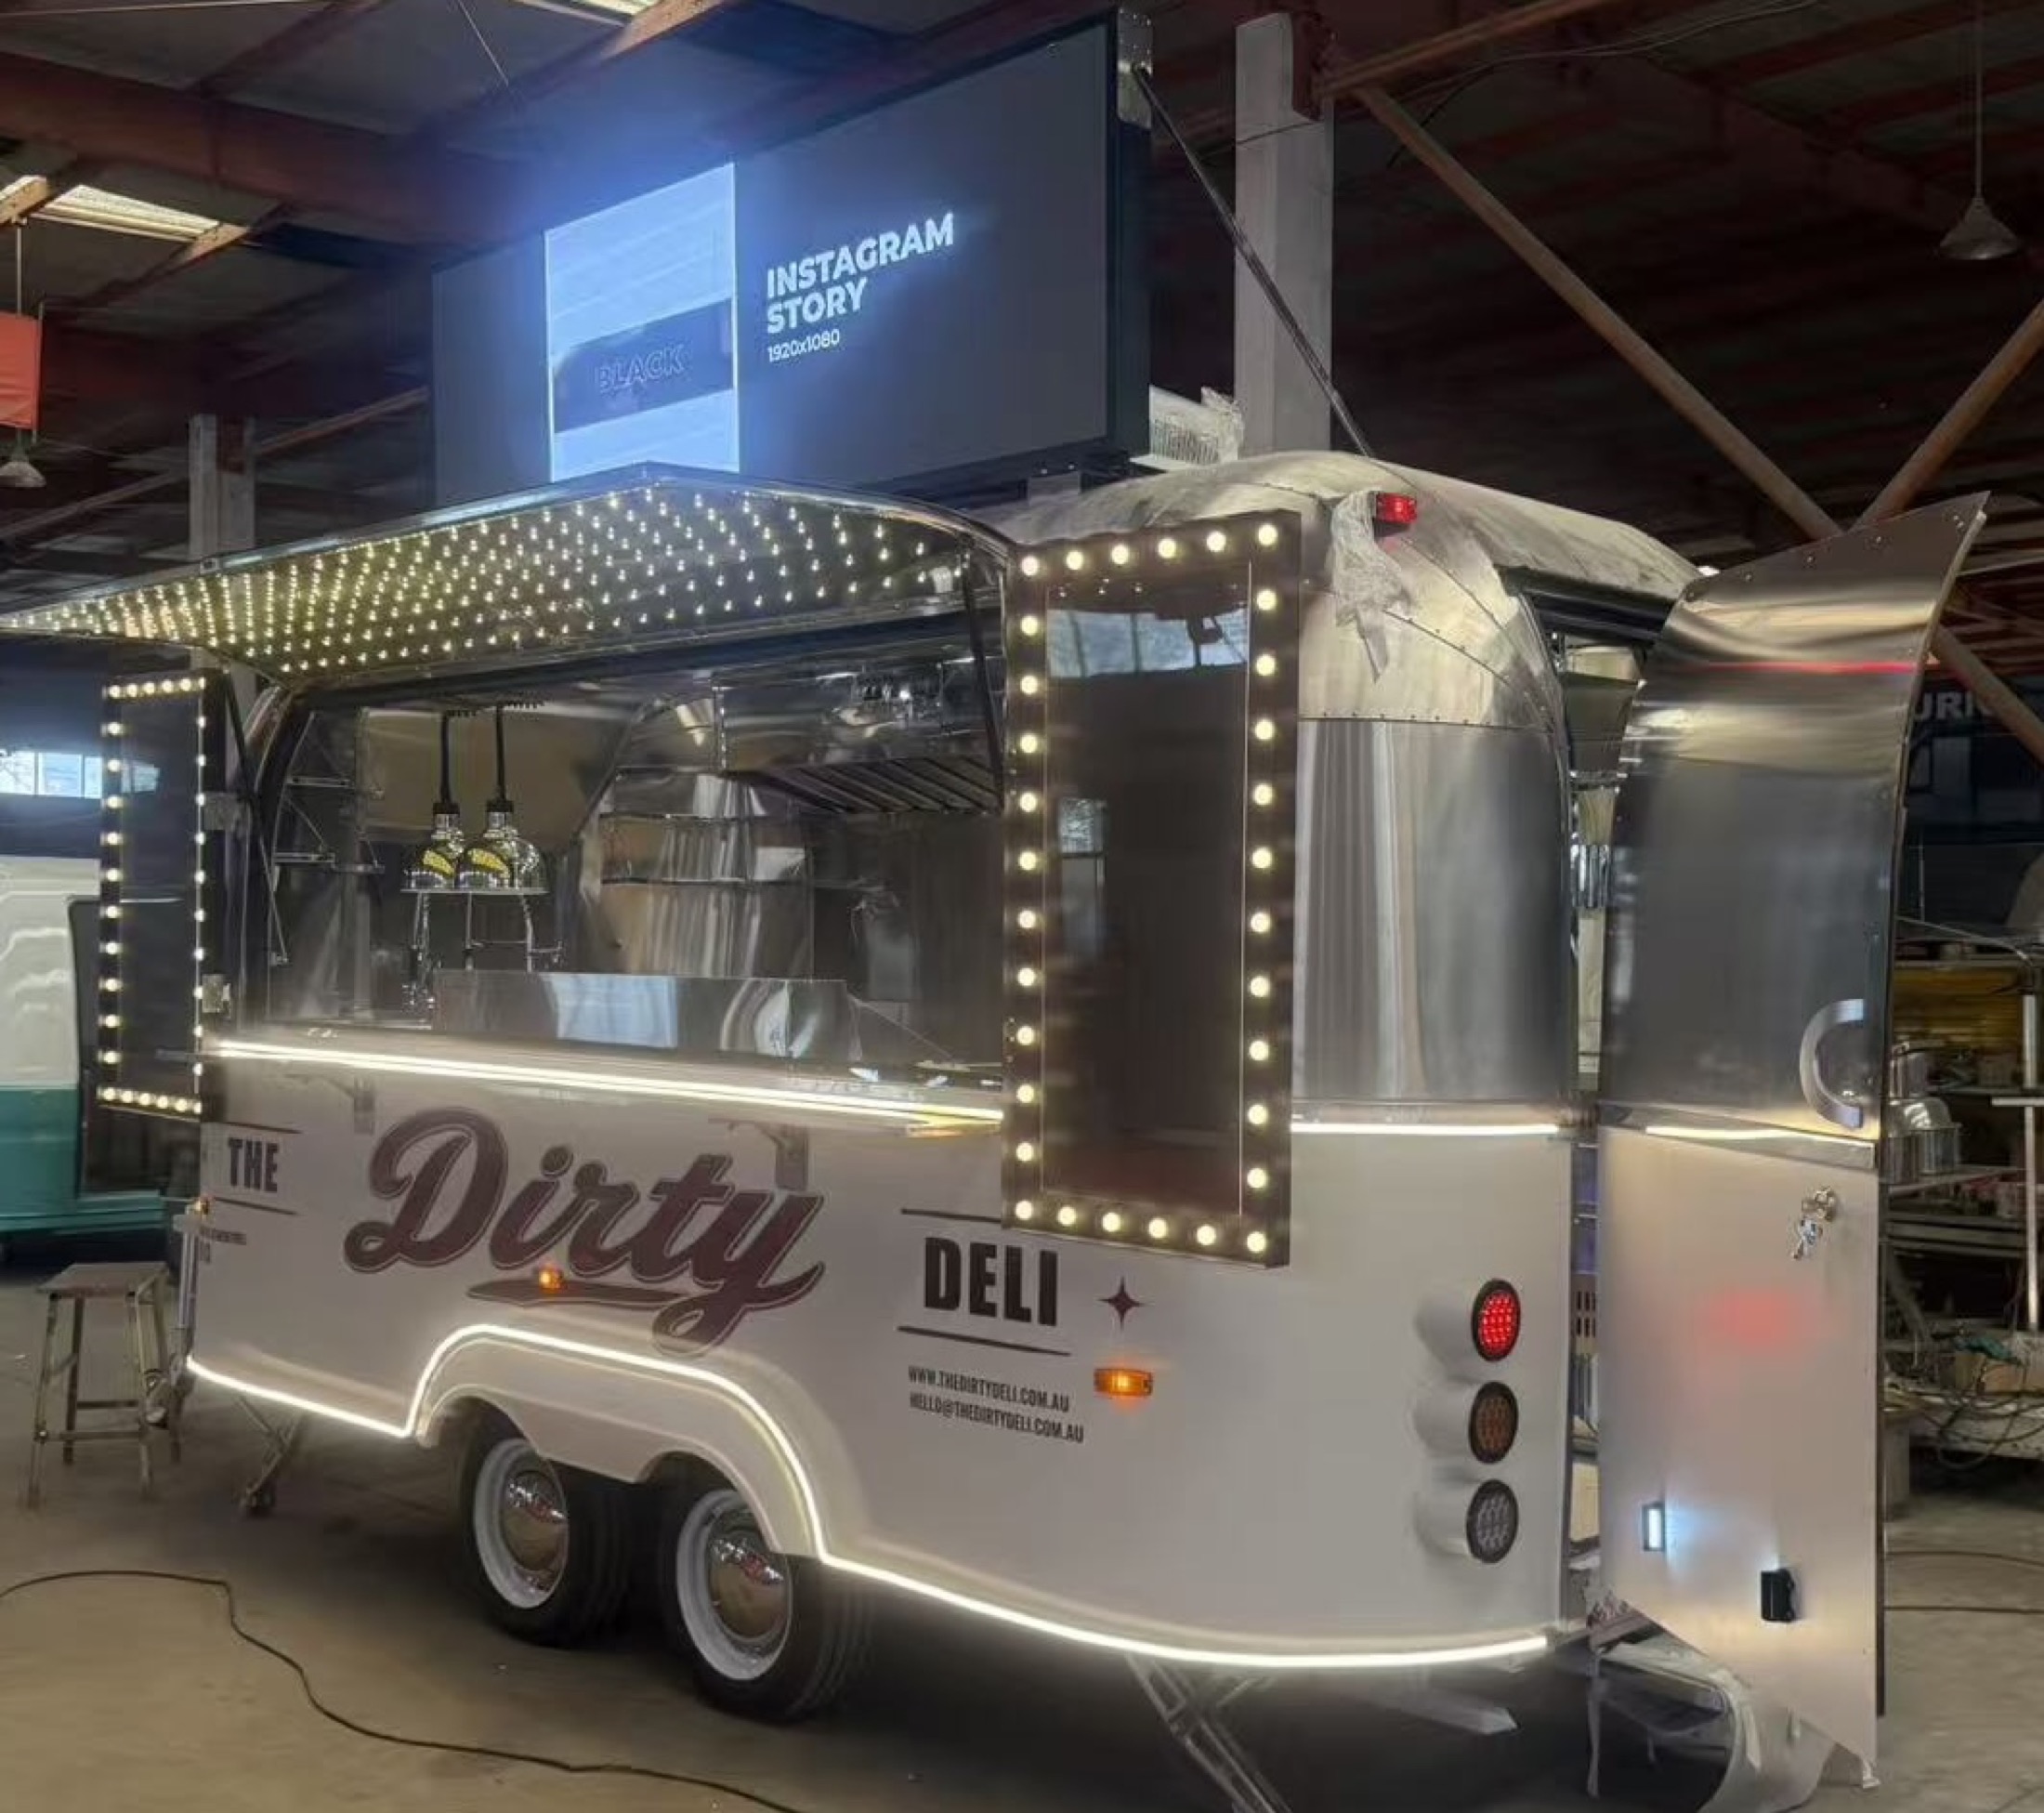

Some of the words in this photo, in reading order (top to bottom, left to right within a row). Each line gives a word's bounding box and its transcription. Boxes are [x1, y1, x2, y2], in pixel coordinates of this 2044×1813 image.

[766, 212, 955, 299] INSTAGRAM
[766, 277, 869, 335] STORY
[595, 343, 687, 394] BLACK
[767, 328, 841, 362] 1920x1080
[229, 1136, 278, 1193] THE
[344, 1107, 826, 1358] Dirty
[924, 1236, 1058, 1327] DELI
[908, 1364, 1069, 1413] WWW.THEDIRTYDELI.COM.AU
[910, 1390, 1084, 1444] HELLO@THEDIRTYDELI.COM.AU
